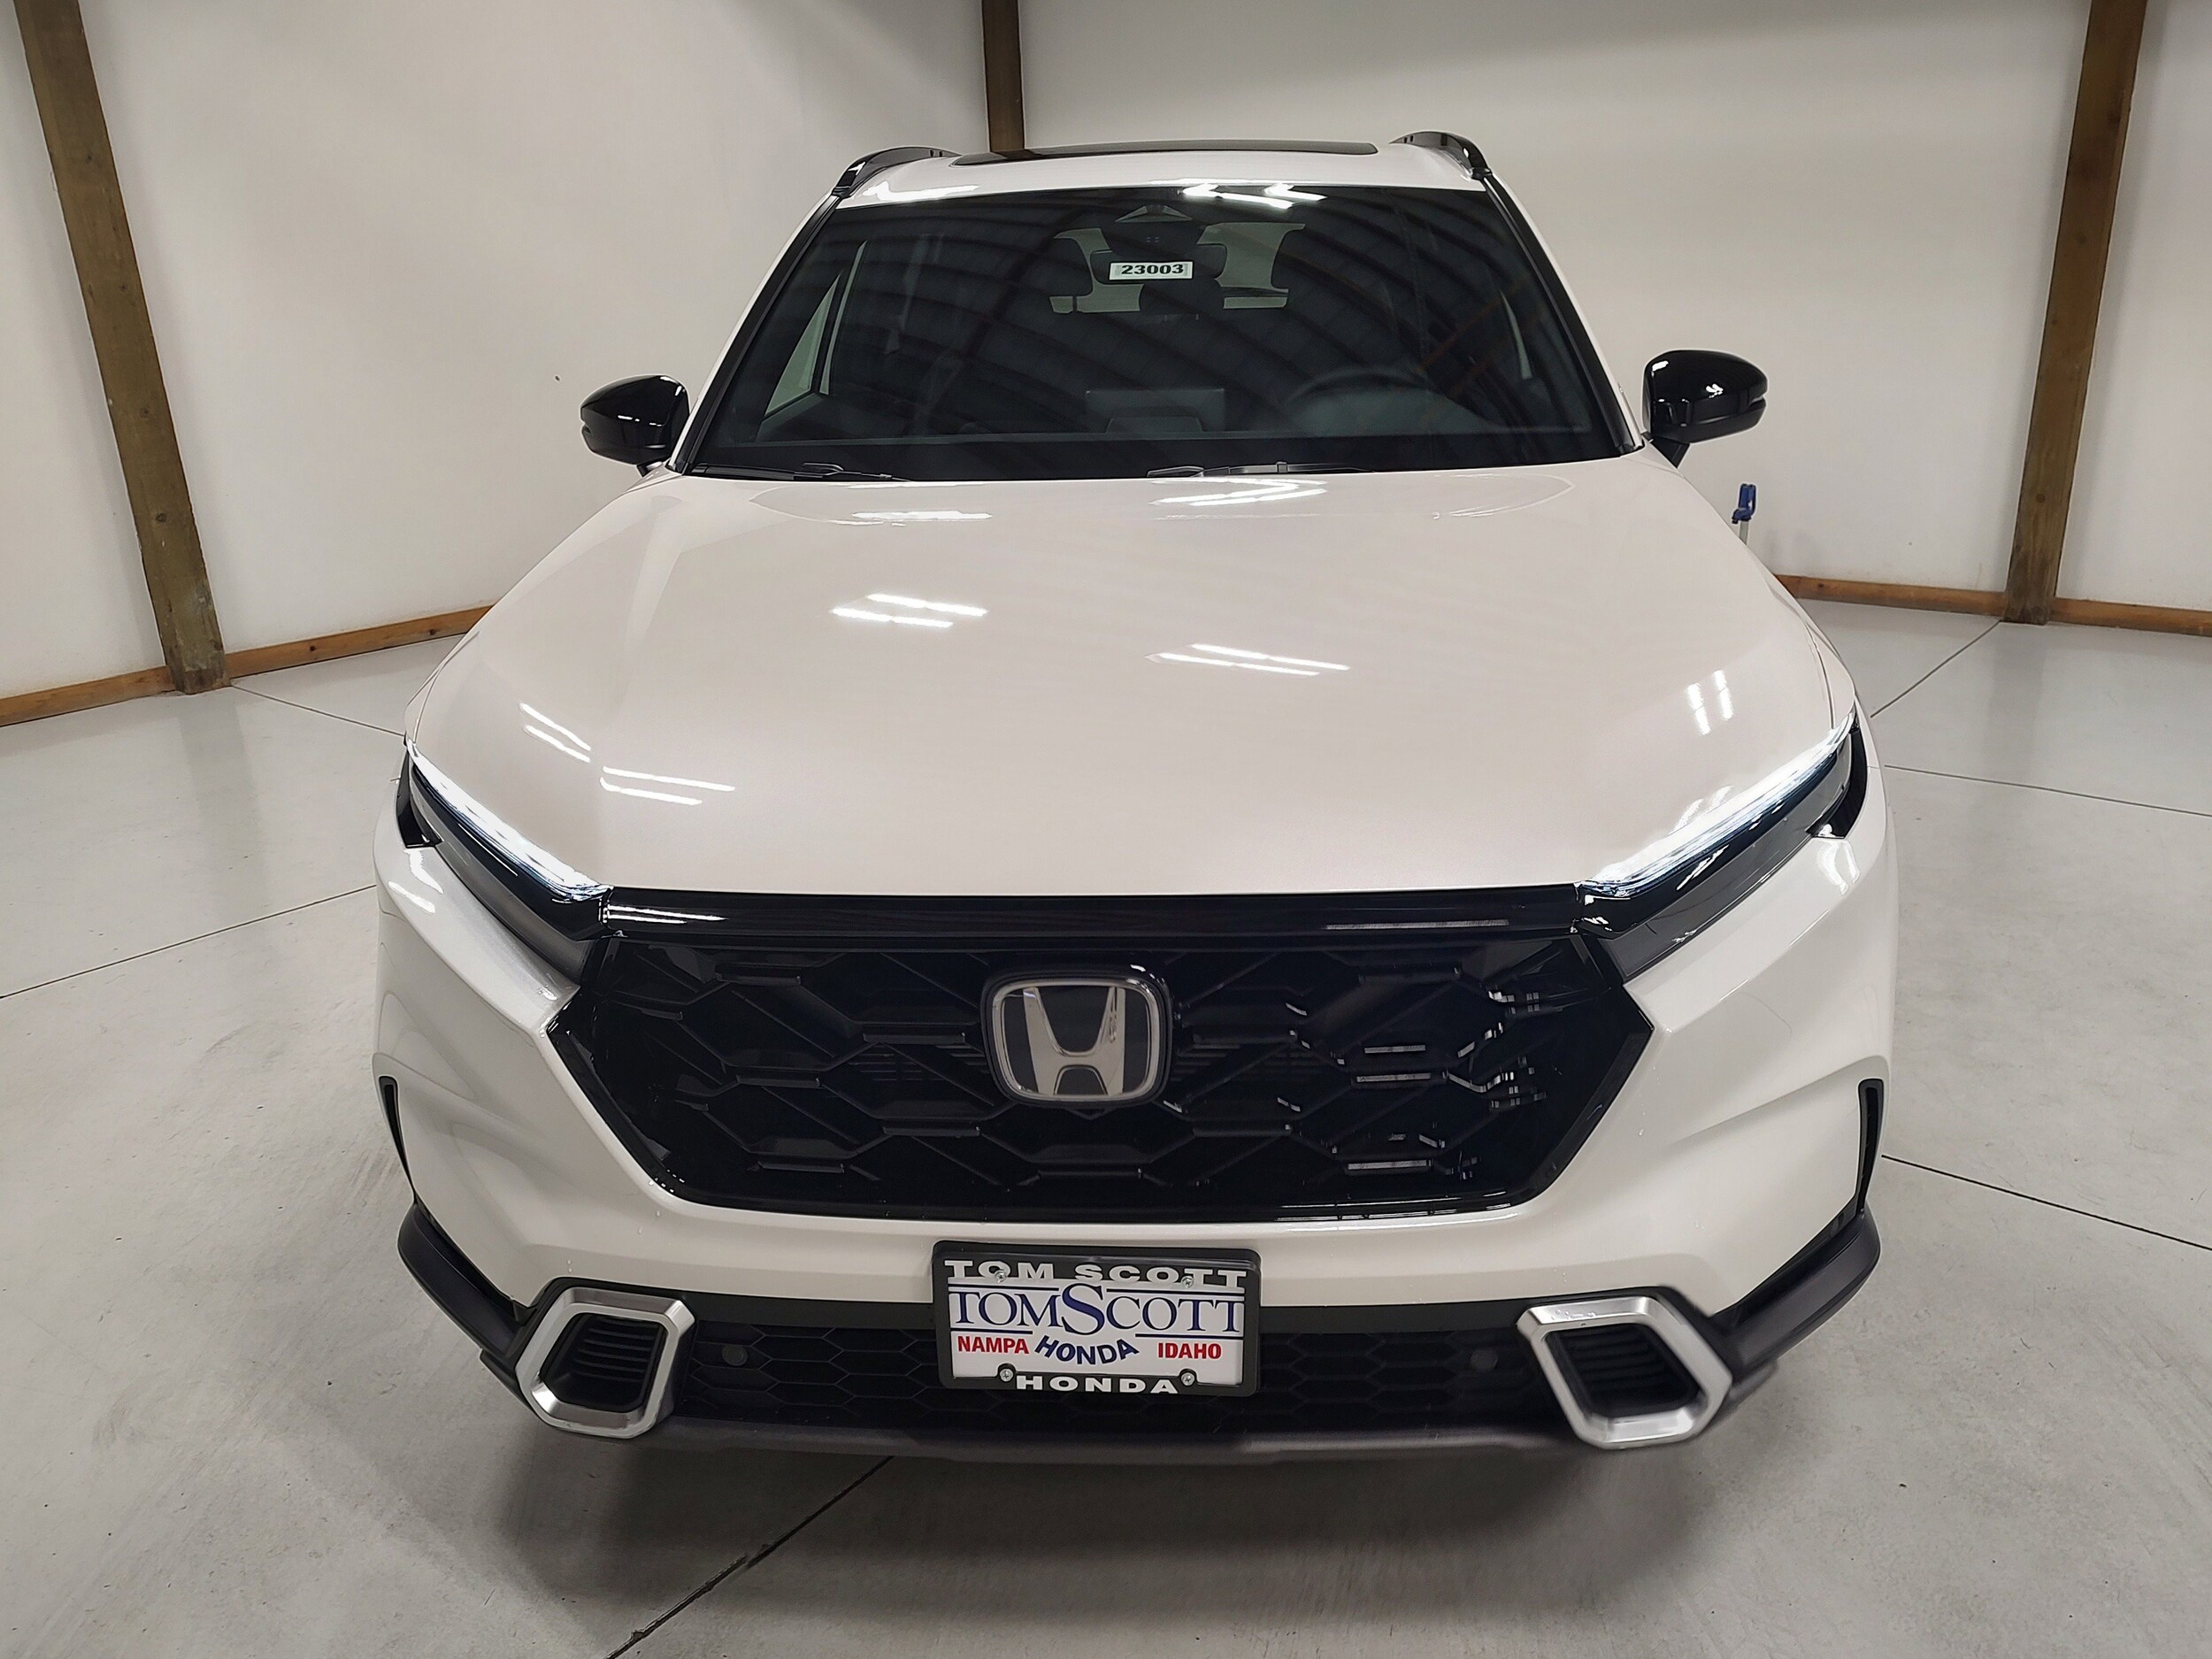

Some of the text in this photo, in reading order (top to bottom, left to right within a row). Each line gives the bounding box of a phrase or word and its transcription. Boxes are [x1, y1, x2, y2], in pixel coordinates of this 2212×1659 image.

[1121, 265, 1185, 275] 23003
[944, 1260, 1247, 1288] TOM SCOTT
[957, 1335, 1030, 1355] NAMPA
[1034, 1335, 1140, 1365] HONDA
[1157, 1342, 1222, 1360] IDAHO
[1016, 1375, 1179, 1394] HONDA
